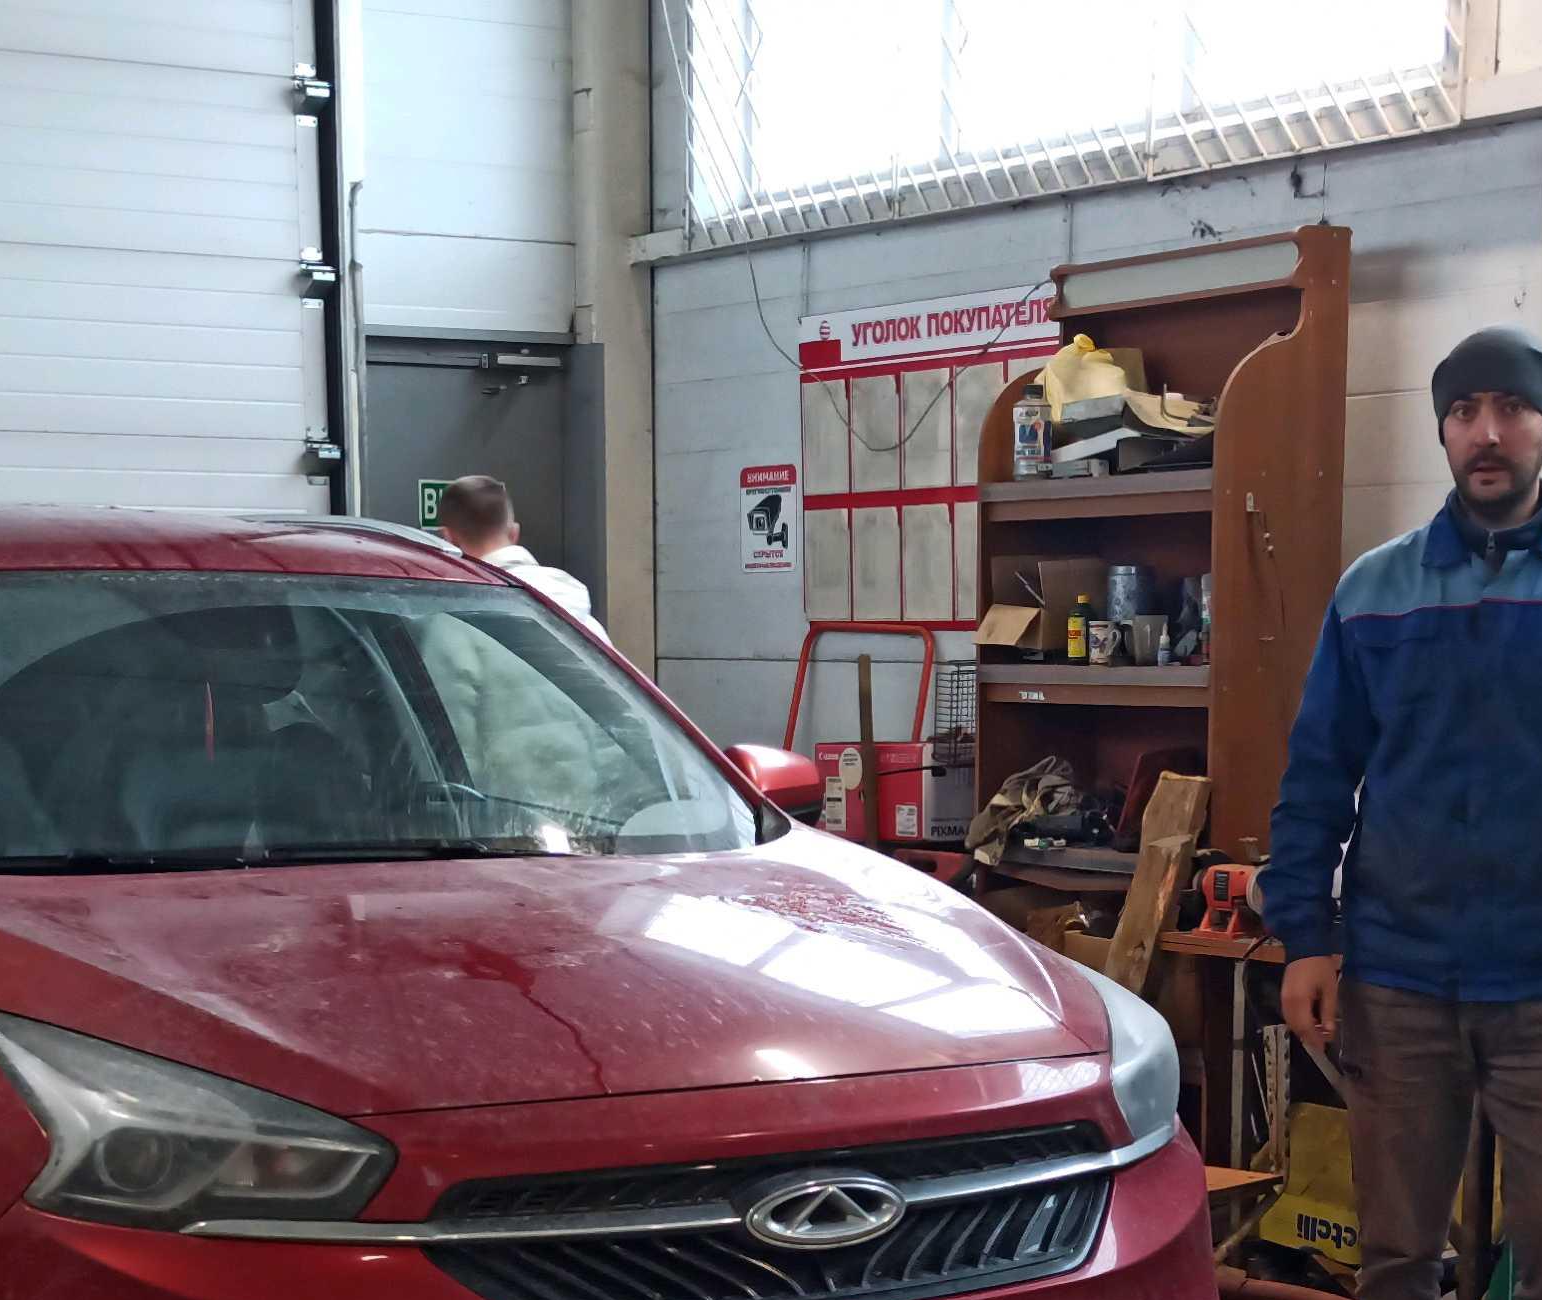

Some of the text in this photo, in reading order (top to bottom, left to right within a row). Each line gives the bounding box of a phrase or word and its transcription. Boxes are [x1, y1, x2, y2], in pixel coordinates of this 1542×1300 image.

[851, 297, 1053, 347] УГОЛОК ПОКУПАТЕЛЯ
[1297, 1213, 1358, 1249] etelli
